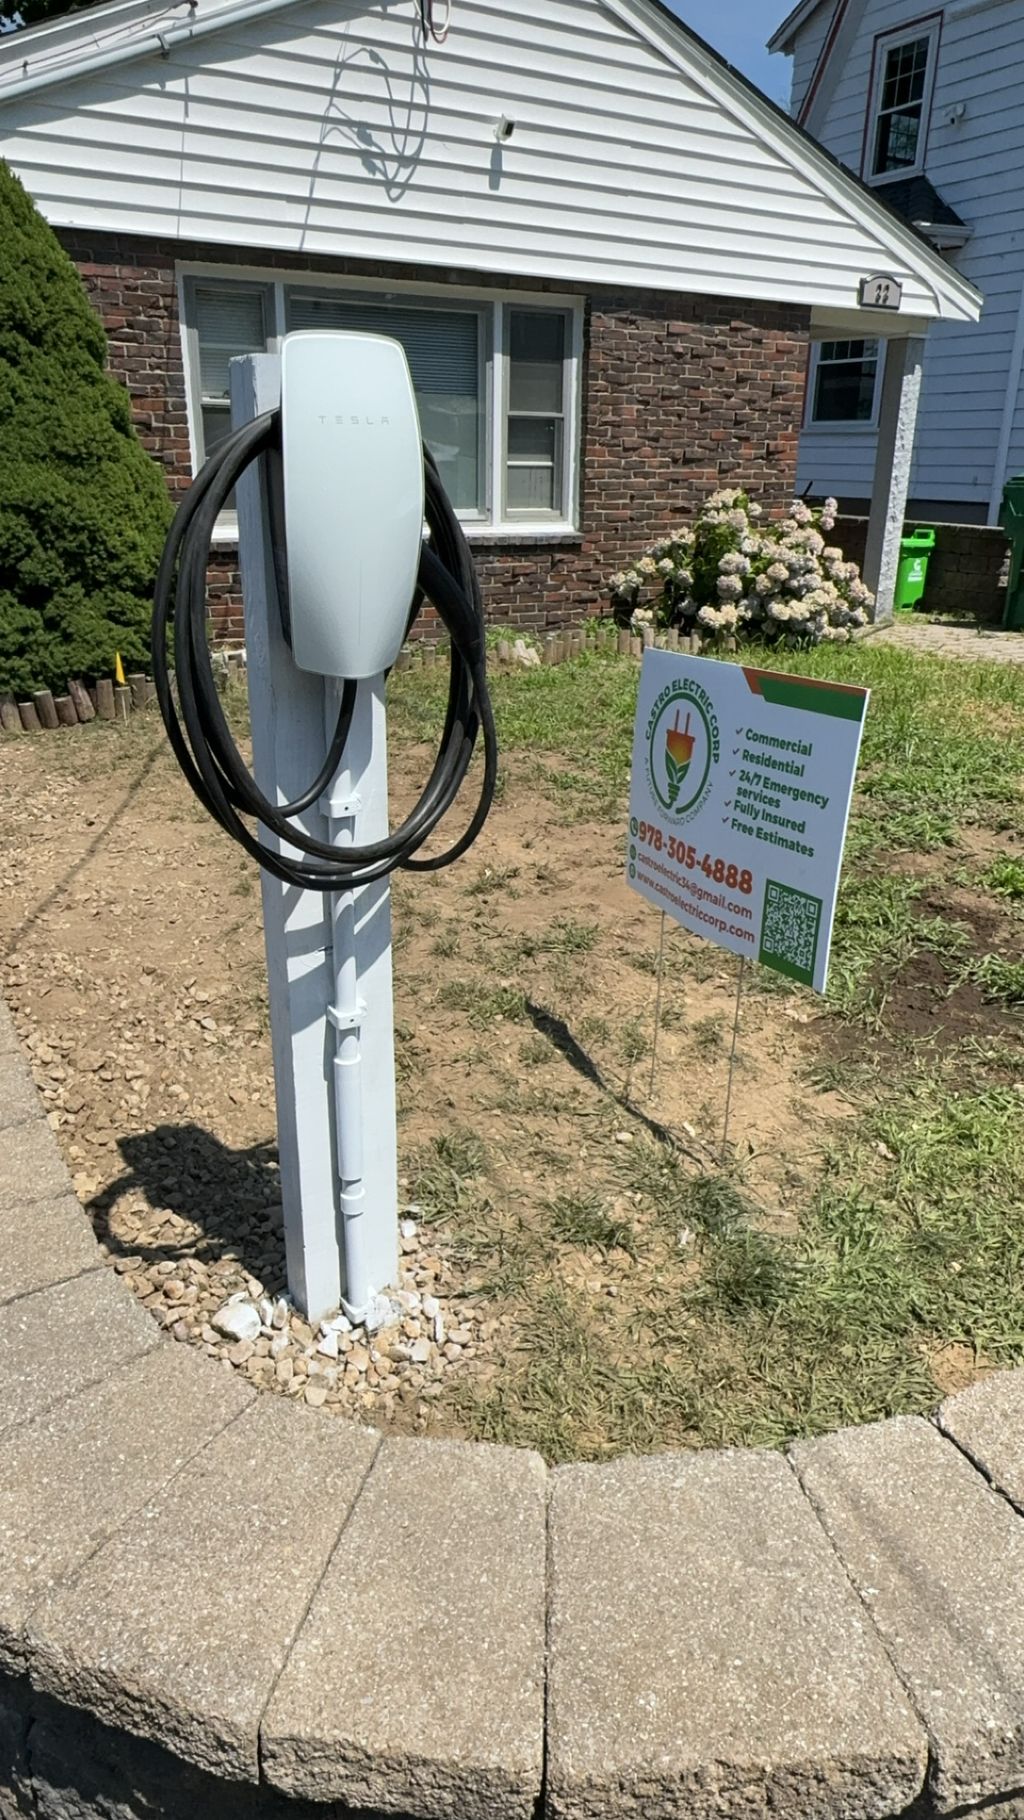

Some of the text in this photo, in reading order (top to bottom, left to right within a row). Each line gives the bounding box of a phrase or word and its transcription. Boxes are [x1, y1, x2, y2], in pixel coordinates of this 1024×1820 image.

[317, 415, 390, 425] TESLA
[645, 678, 720, 764] CASTRO ELECTRIC CORP
[745, 728, 813, 757] Commercial
[742, 749, 805, 777] Residential
[685, 780, 714, 824] COMPANY
[736, 786, 781, 809] services
[739, 769, 829, 809] 24/7 Emergency
[733, 799, 806, 834] Fully Insured
[731, 818, 815, 857] Free Estimates
[638, 820, 753, 895] 978-305-4888
[638, 852, 752, 920] castroelectric34@gmail.com
[637, 871, 755, 943] www.castroelectriccorp.com
